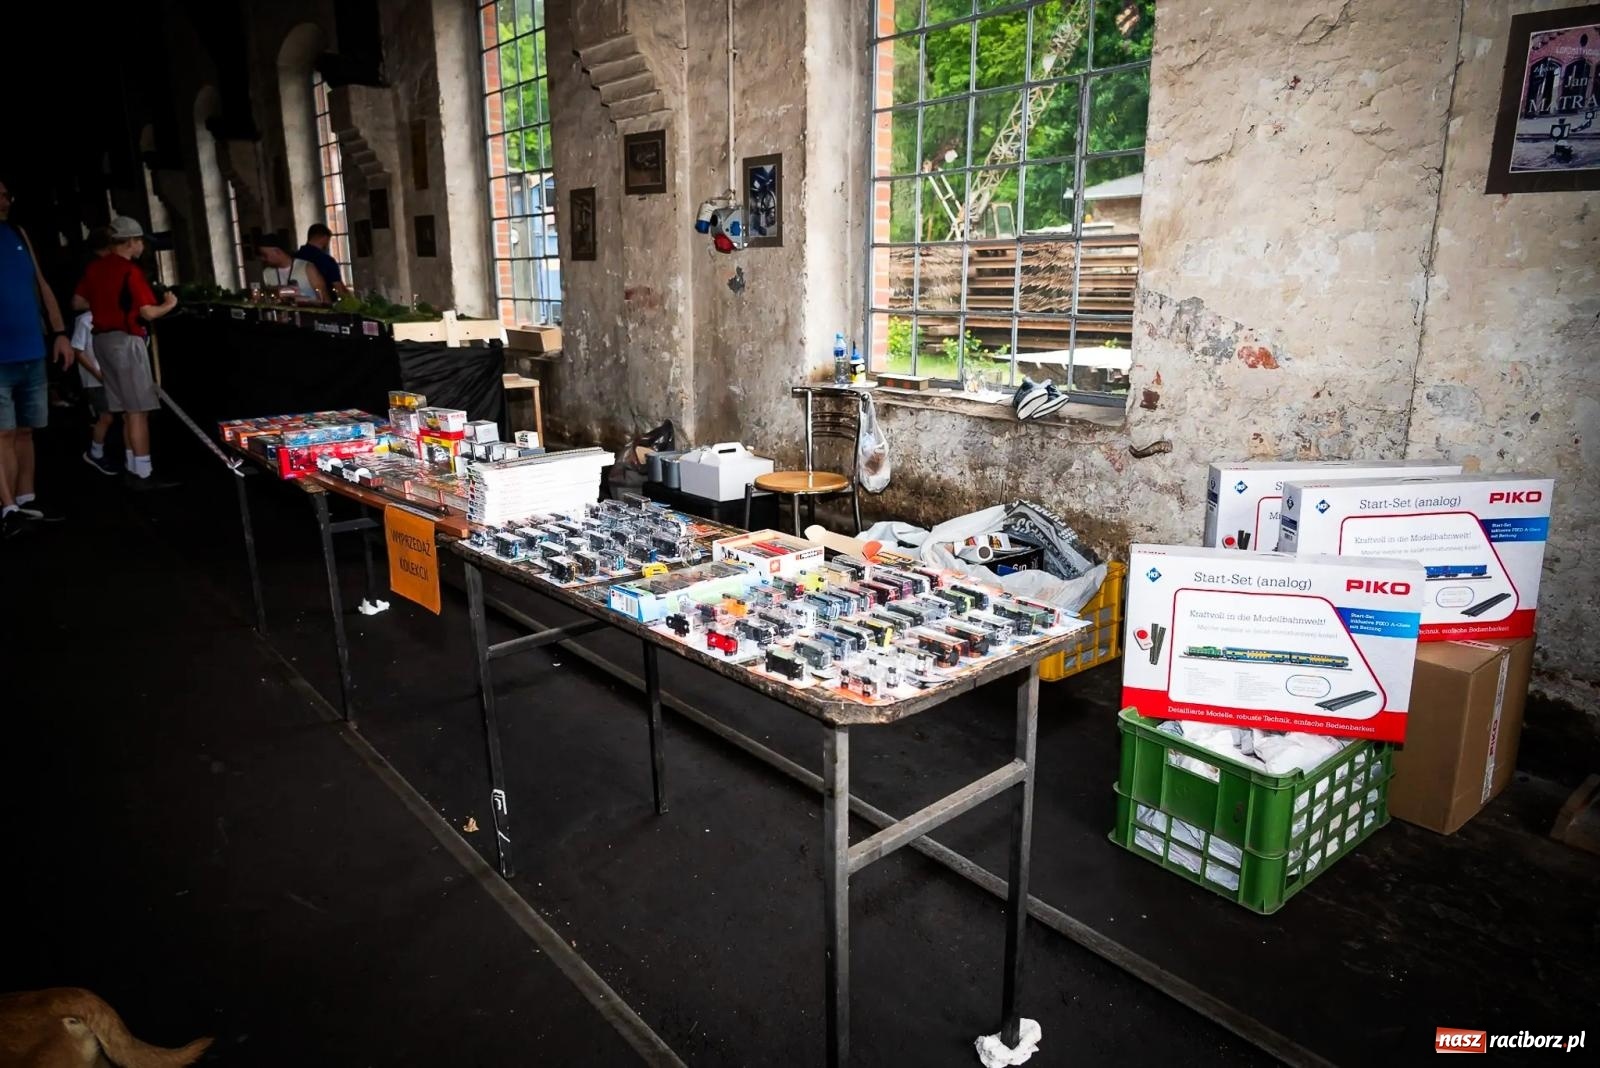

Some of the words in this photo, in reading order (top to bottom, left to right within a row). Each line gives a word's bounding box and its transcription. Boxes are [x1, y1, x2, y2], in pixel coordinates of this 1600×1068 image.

[1564, 75, 1588, 88] Jan
[1359, 497, 1411, 510] Start-Set
[1415, 496, 1462, 509] (analog)
[1488, 490, 1542, 504] PIKO
[1193, 571, 1253, 586] Start-Set
[1256, 575, 1312, 591] (analog)
[1345, 579, 1411, 596] PIKO
[1189, 609, 1225, 620] Kraftvoll
[1226, 612, 1236, 621] in
[1237, 612, 1251, 622] die
[1253, 613, 1326, 626] Modellbahnwelt!
[1167, 705, 1205, 716] Detaillierte
[1236, 712, 1262, 722] robuste
[1293, 718, 1324, 728] einfache
[1326, 721, 1375, 733] Bedienbarkeit
[1489, 719, 1498, 756] PIKO
